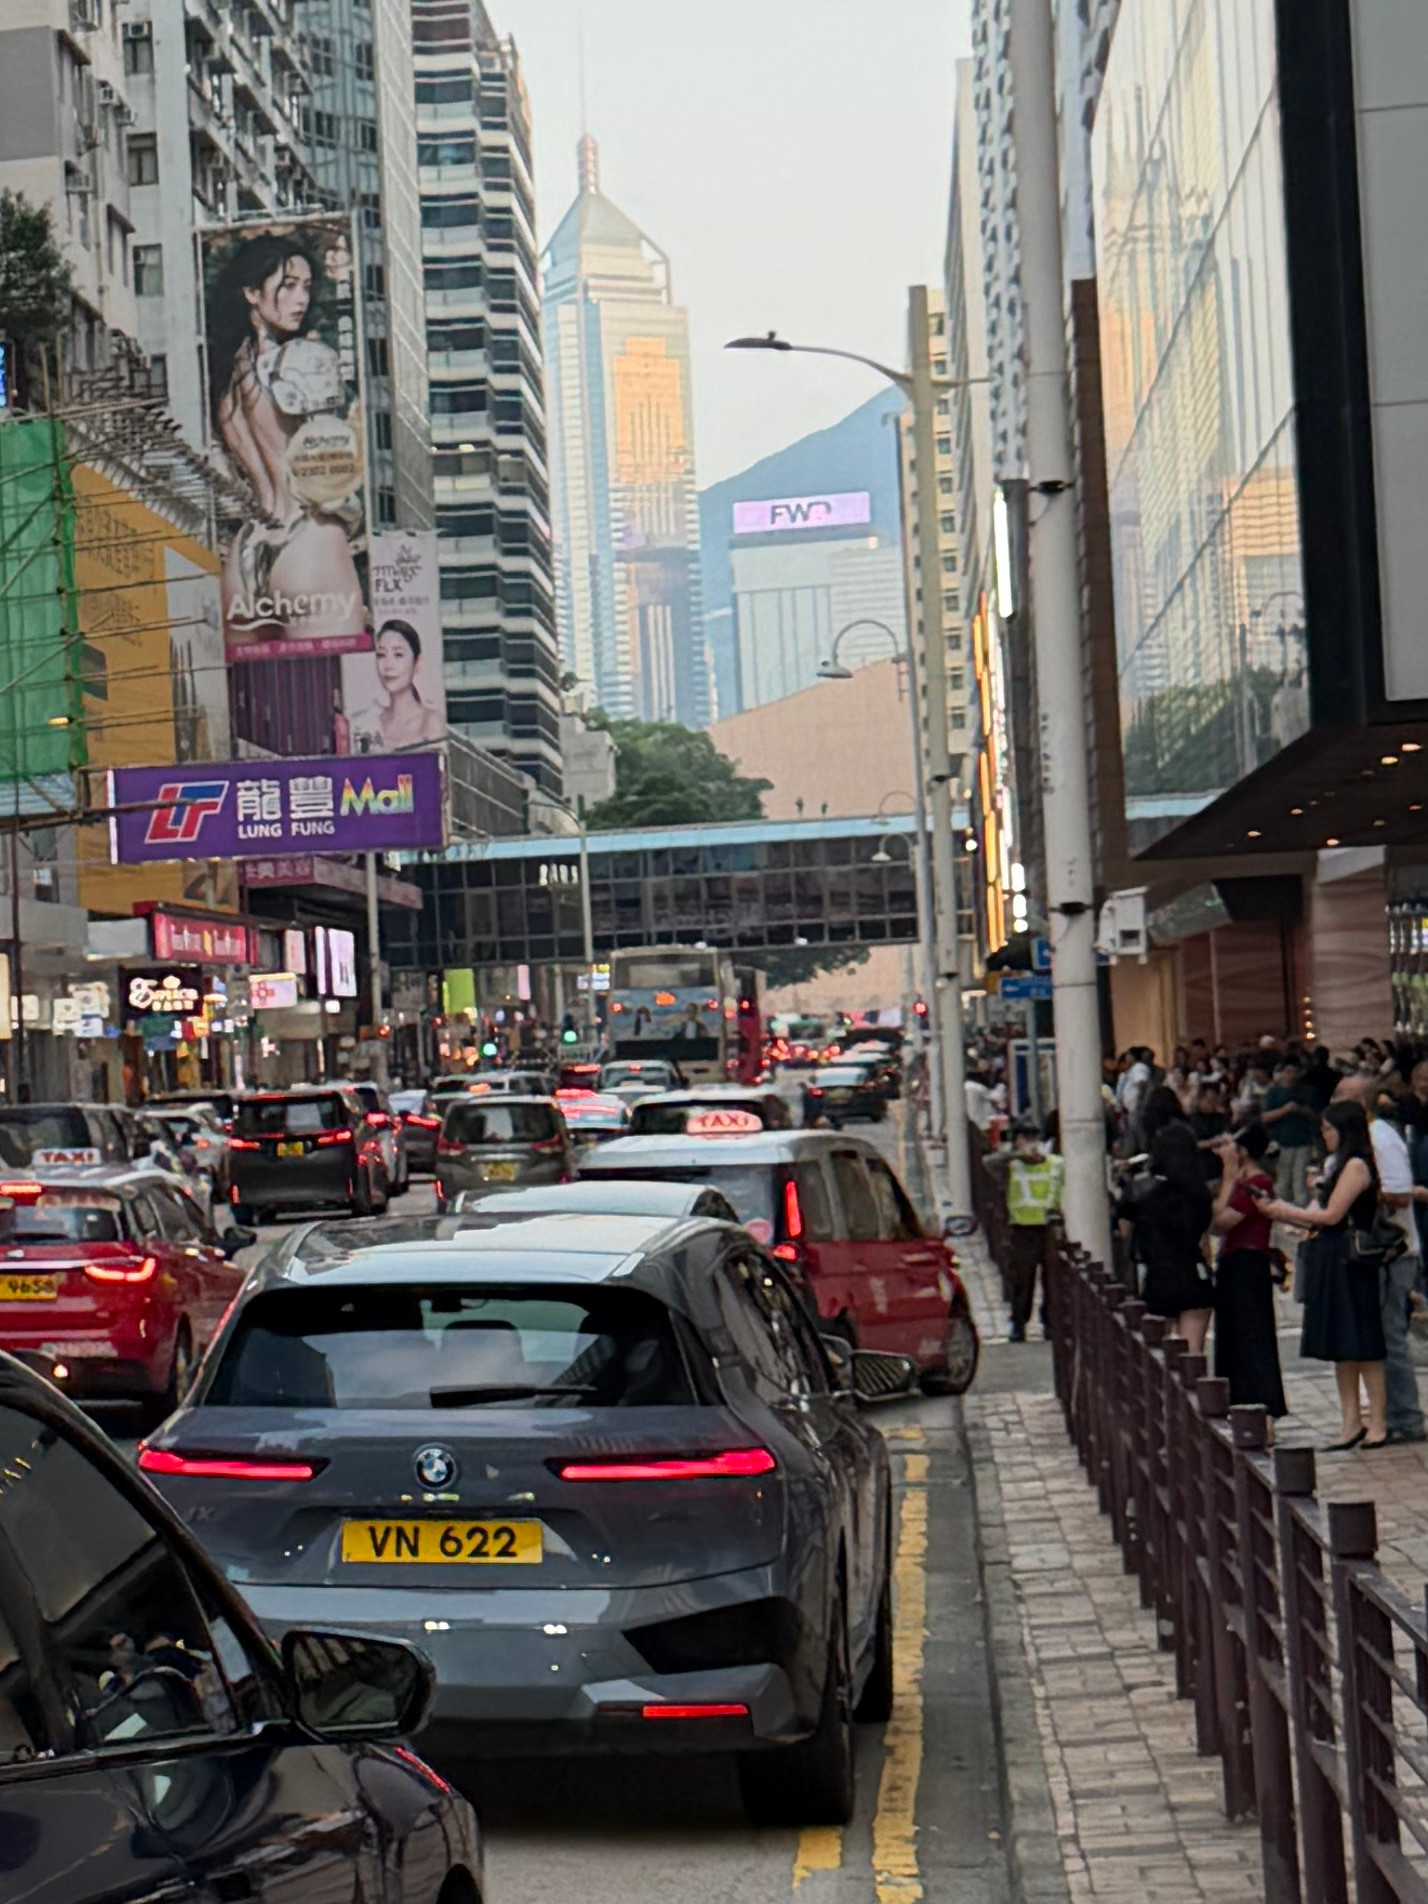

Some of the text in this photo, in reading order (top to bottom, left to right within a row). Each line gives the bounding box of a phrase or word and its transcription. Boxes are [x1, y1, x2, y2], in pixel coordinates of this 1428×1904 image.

[226, 590, 356, 623] Alchemy
[236, 776, 335, 822] 龍豐
[339, 773, 415, 817] Mall
[238, 820, 336, 840] LUNG FUNG
[697, 1113, 749, 1128] TAXI
[40, 1150, 95, 1164] TAXI
[368, 1525, 518, 1558] VN 622
